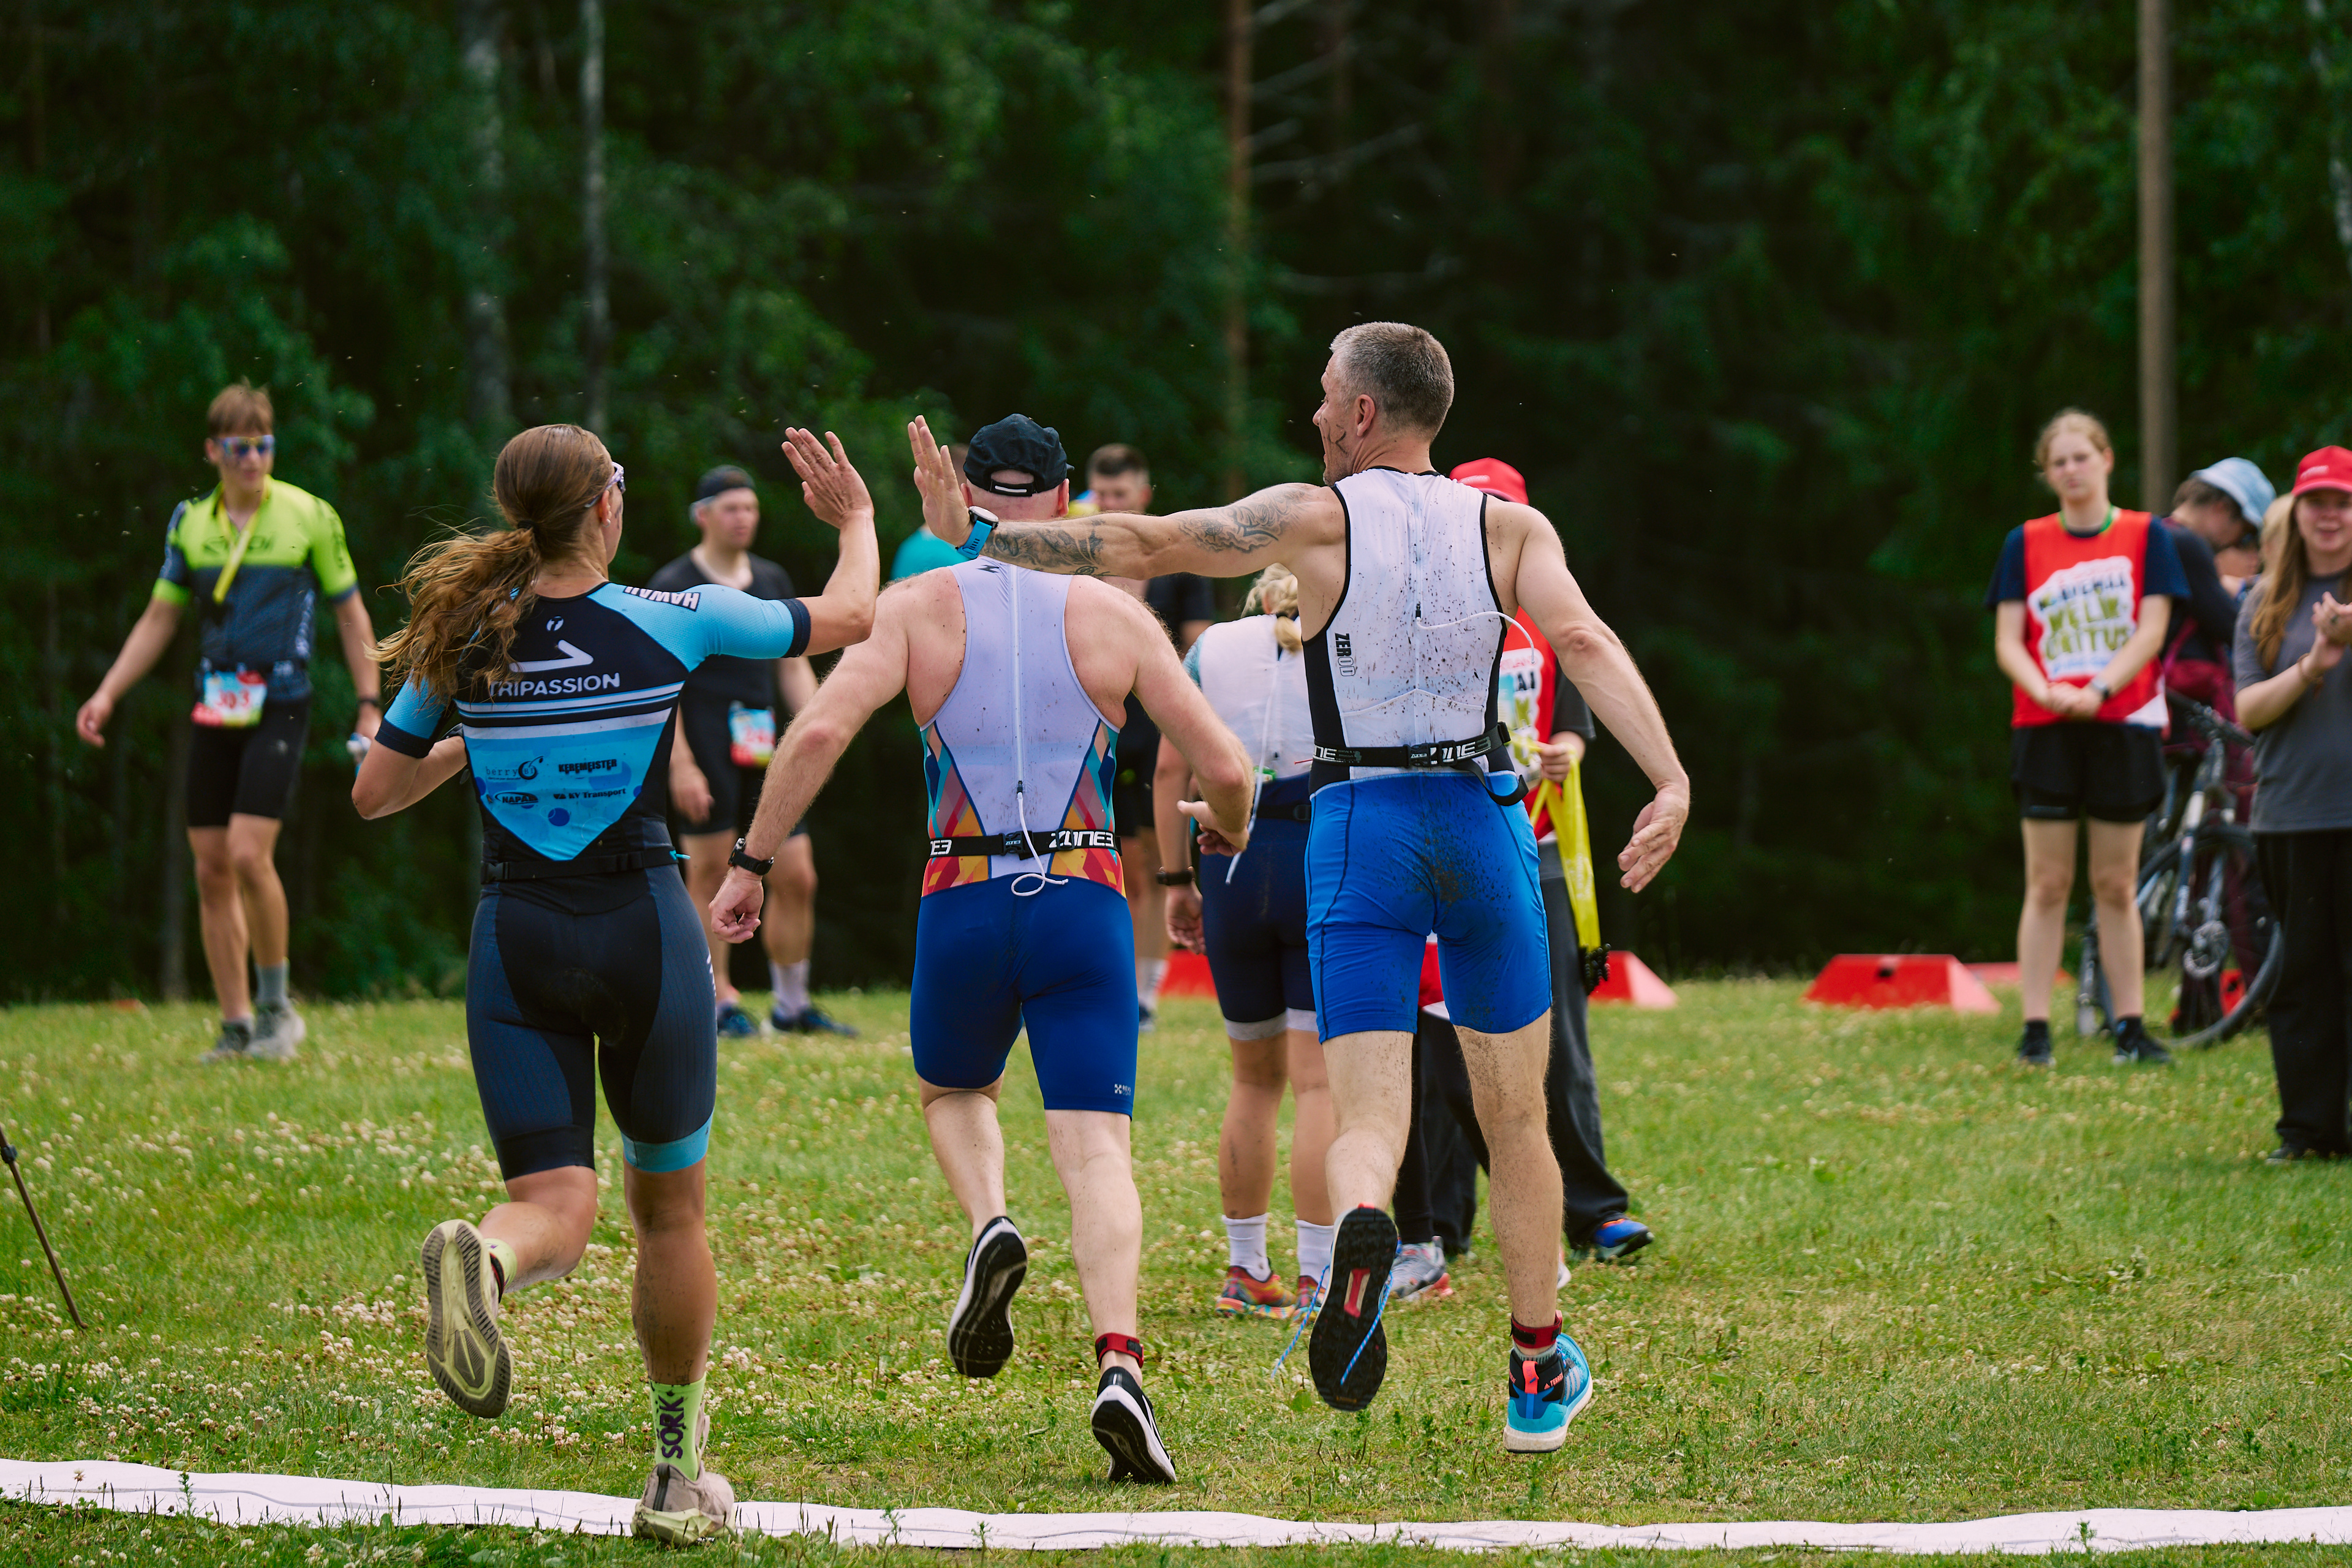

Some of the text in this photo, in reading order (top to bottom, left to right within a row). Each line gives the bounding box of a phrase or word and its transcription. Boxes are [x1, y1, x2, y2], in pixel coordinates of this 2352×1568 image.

[624, 586, 700, 609] HAWAII
[1335, 633, 1356, 676] ZEROD
[491, 673, 620, 696] TRIPASSION
[583, 788, 626, 799] Transport
